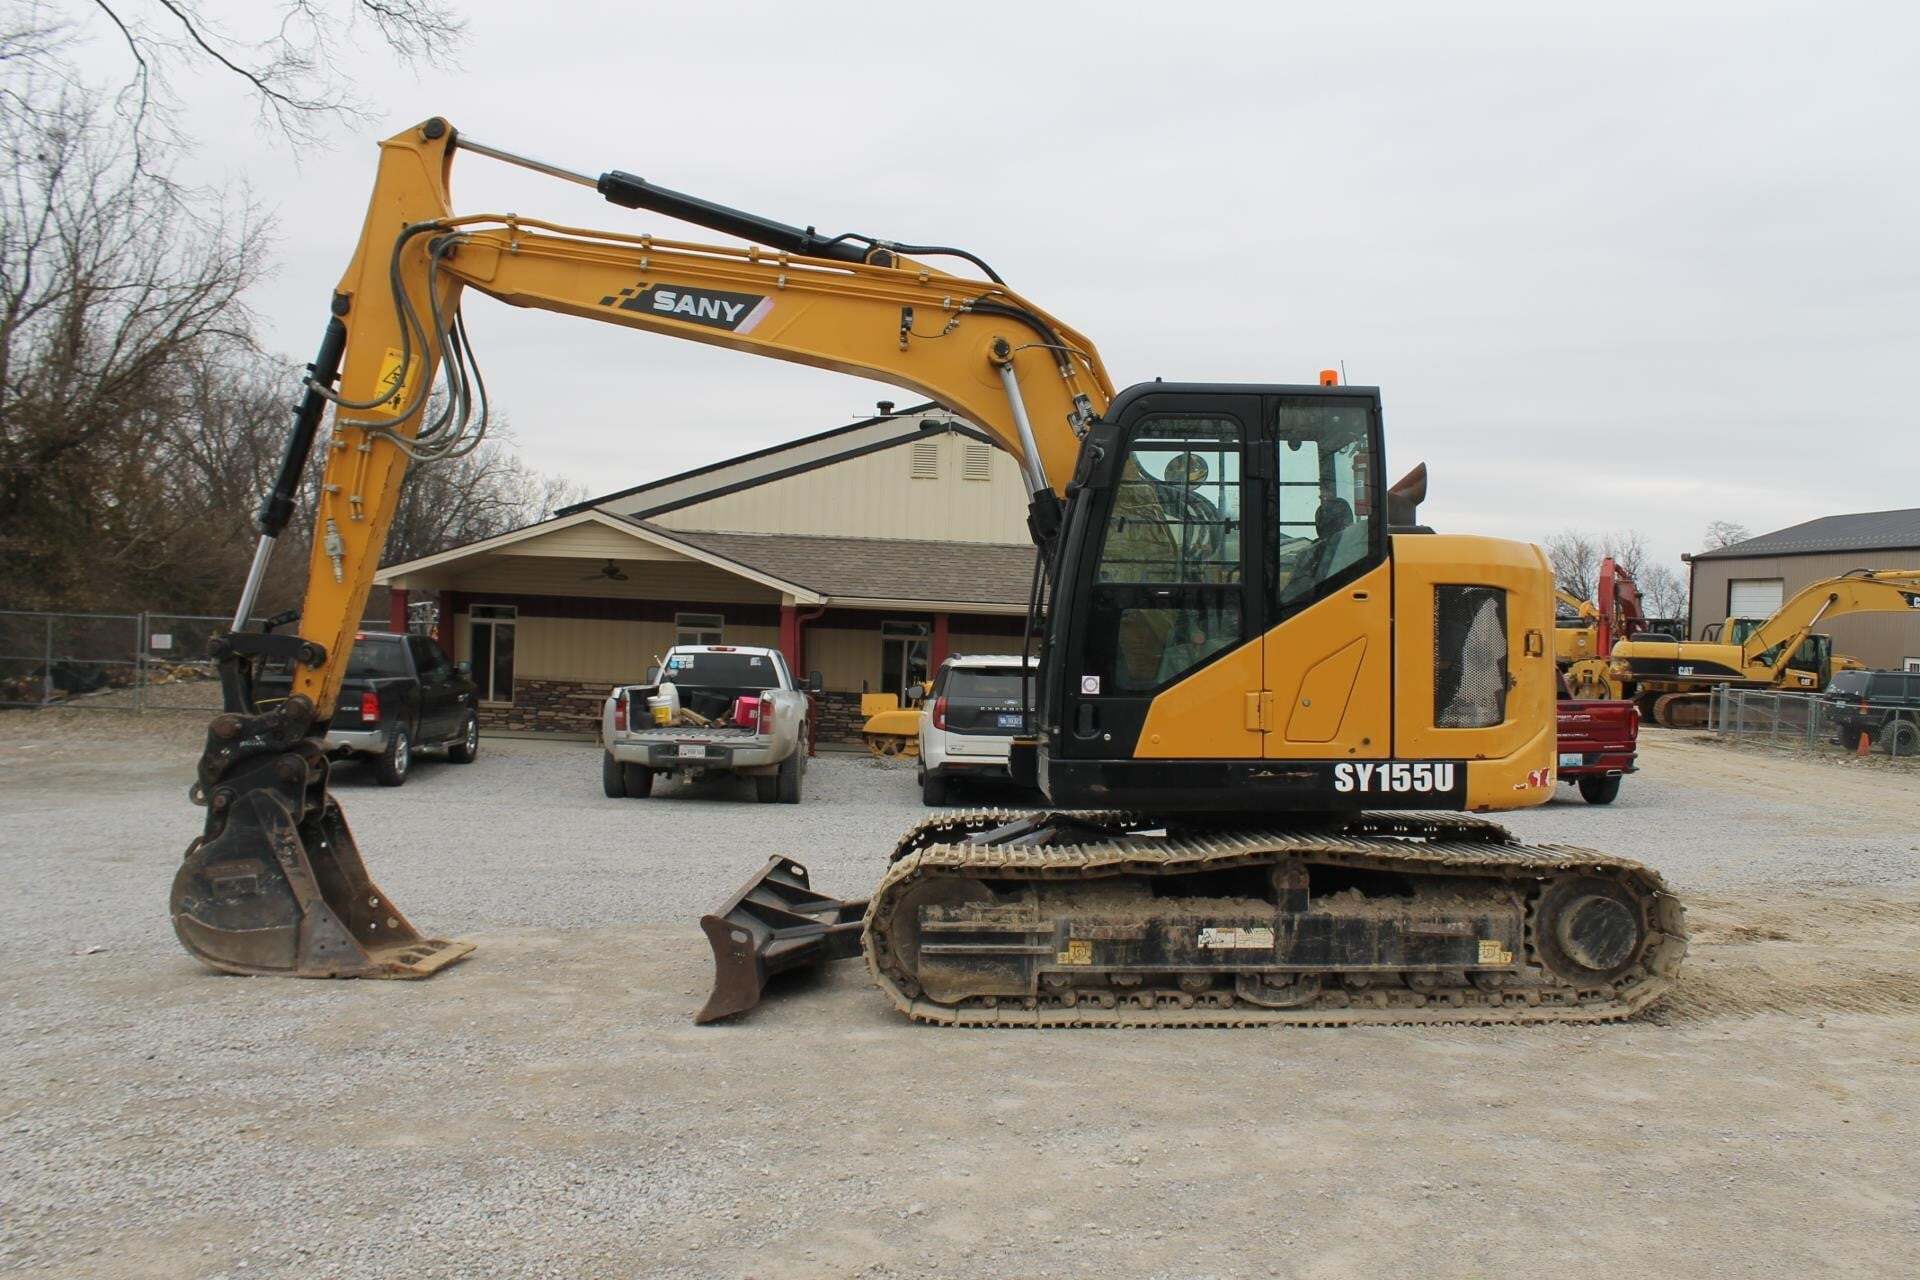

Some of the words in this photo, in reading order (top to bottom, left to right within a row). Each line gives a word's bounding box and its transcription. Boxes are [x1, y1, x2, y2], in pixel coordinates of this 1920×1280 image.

[652, 290, 745, 322] SANY
[1678, 666, 1694, 676] CAT
[1334, 763, 1454, 792] SY155U
